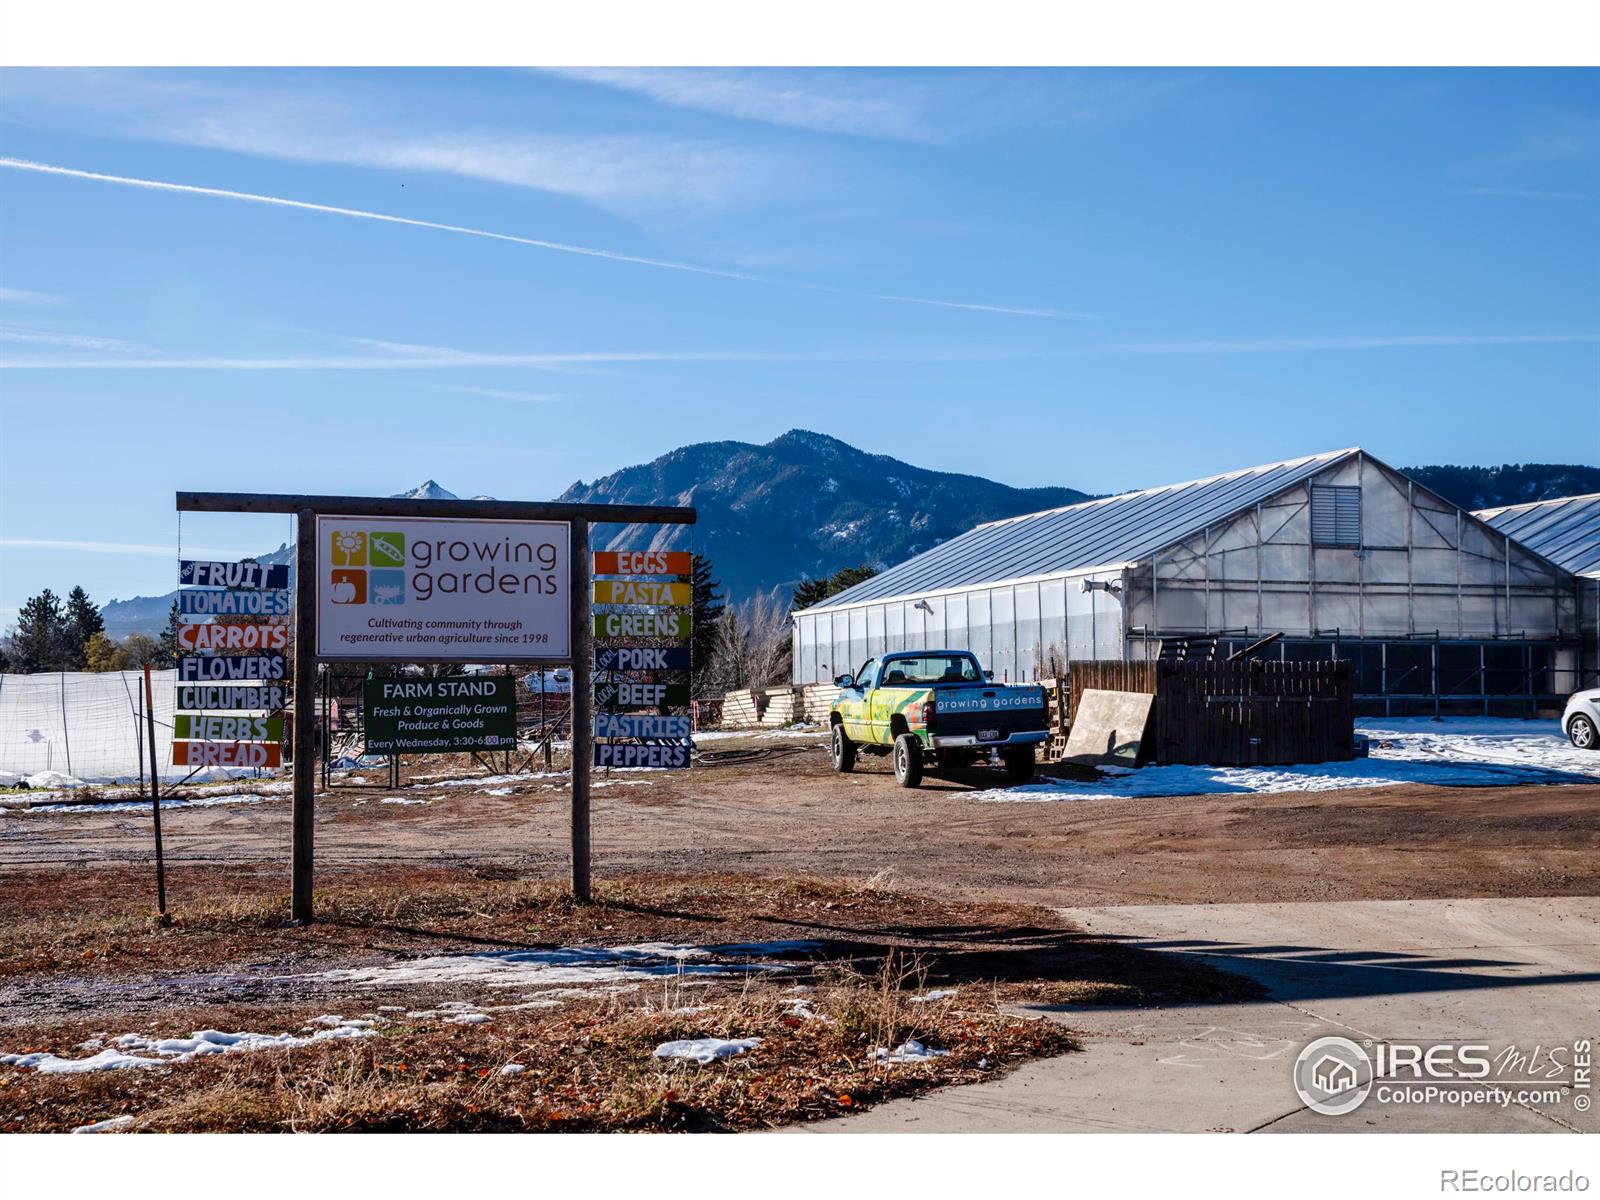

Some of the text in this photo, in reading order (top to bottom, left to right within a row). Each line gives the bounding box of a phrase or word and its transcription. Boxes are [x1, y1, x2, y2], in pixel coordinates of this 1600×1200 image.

[411, 537, 557, 571] growing
[617, 552, 667, 574] EGGS
[193, 562, 274, 587] FRUIT
[412, 566, 558, 601] gardens
[182, 592, 288, 614] TOMATOES
[611, 582, 674, 604] PASTA
[367, 618, 523, 631] Cultivating community through
[606, 614, 679, 637] GREENS
[178, 624, 286, 649] CARROTS
[340, 633, 549, 645] regenerative urban agriculture since 1998
[183, 656, 284, 681] FLOWERS
[595, 648, 618, 670] LOCAL
[618, 648, 669, 670] PORK
[182, 687, 282, 709] CUCUMBER
[383, 681, 496, 698] FARM STAND
[594, 683, 619, 706] LOCAL
[618, 684, 667, 705] BEEF
[373, 704, 507, 718] Fresh & Organically Grown
[937, 695, 1042, 711] growing gardens
[189, 715, 268, 740] HERBS
[397, 718, 485, 730] Produce & Goods
[595, 715, 691, 738] PASTRIES
[368, 735, 515, 749] Every Wednesday, 3:30-6:00 pm
[187, 743, 268, 768] BREAD
[599, 744, 686, 767] PEPPERS
